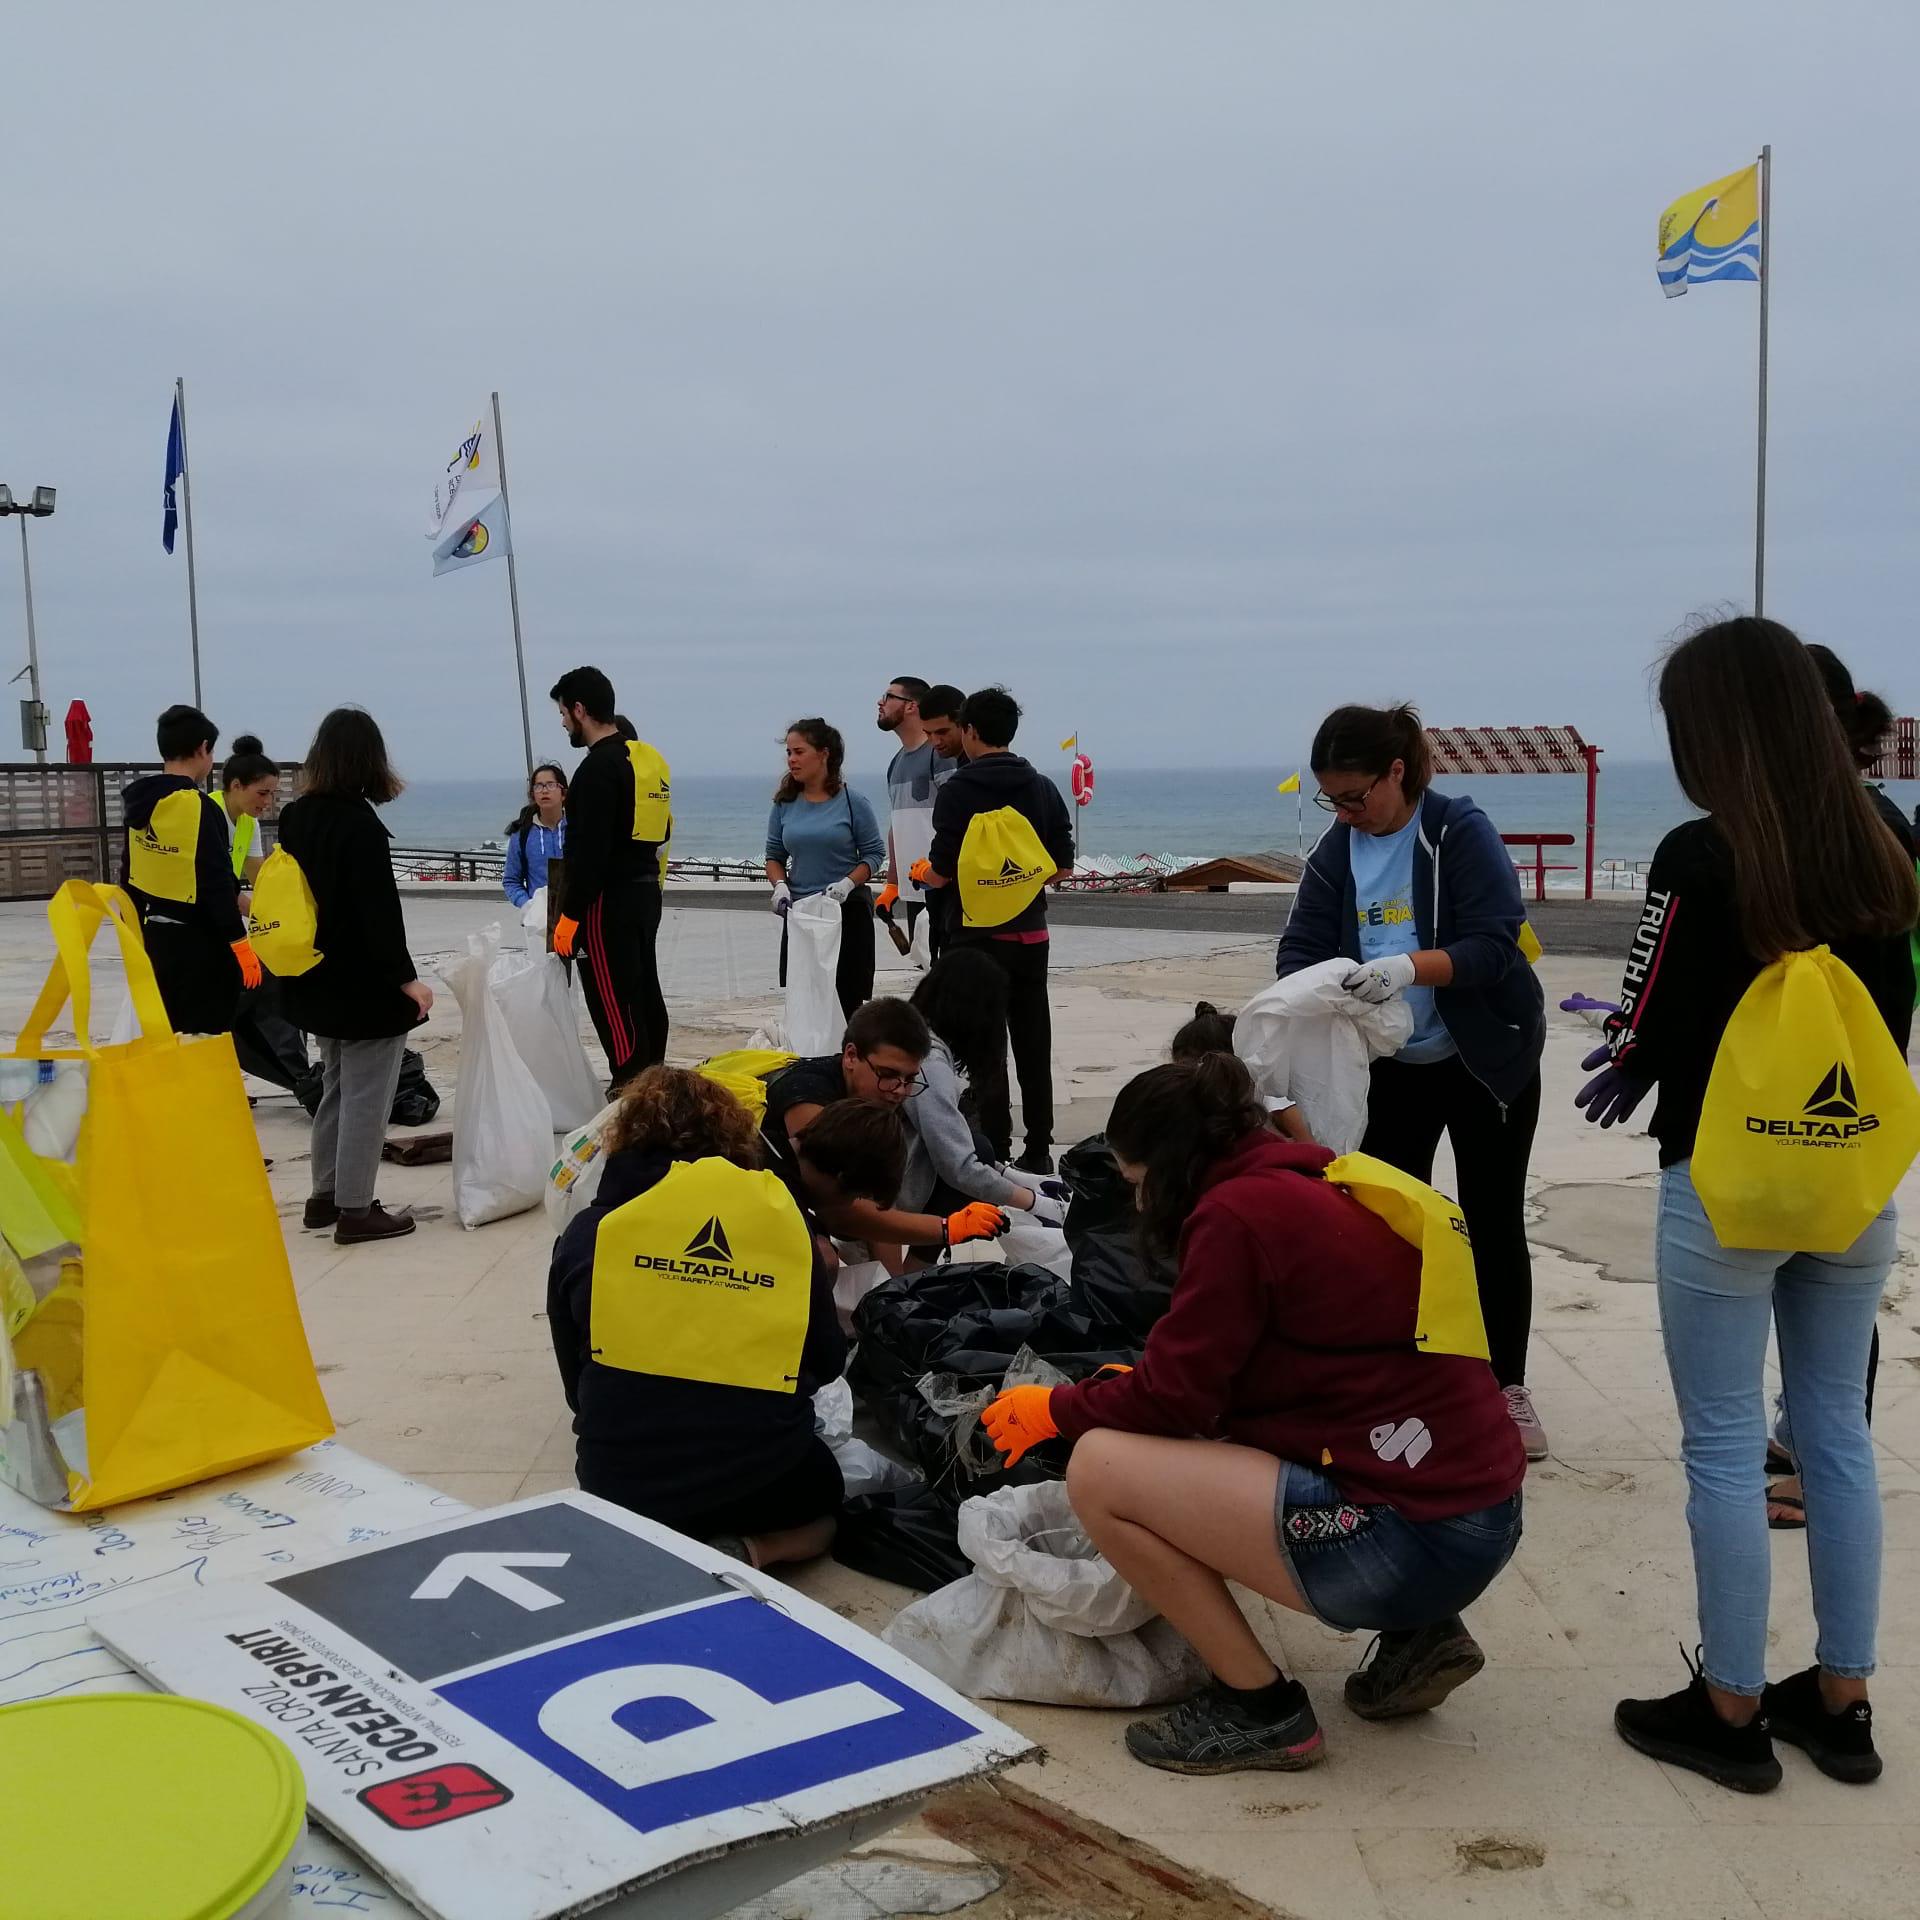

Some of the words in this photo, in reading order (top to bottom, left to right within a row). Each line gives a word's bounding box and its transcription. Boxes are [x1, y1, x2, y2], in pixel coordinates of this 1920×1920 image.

[977, 866, 1043, 886] DELTAPLUS
[248, 920, 281, 933] PLUS
[1357, 901, 1415, 927] FÉRIA
[1625, 891, 1671, 983] TRUTH
[1621, 987, 1637, 1015] IS
[1801, 1139, 1847, 1149] SAFETY
[634, 1255, 775, 1288] DELTAPLUS
[657, 1273, 680, 1282] YOUR
[680, 1276, 715, 1286] SAFETY
[724, 1282, 751, 1292] WORK
[224, 1629, 339, 1688] SPIRIT
[241, 1680, 315, 1723] CRUZ
[306, 1684, 439, 1763] OCEAN
[537, 1663, 905, 1790] P
[296, 1718, 383, 1777] SANTA
